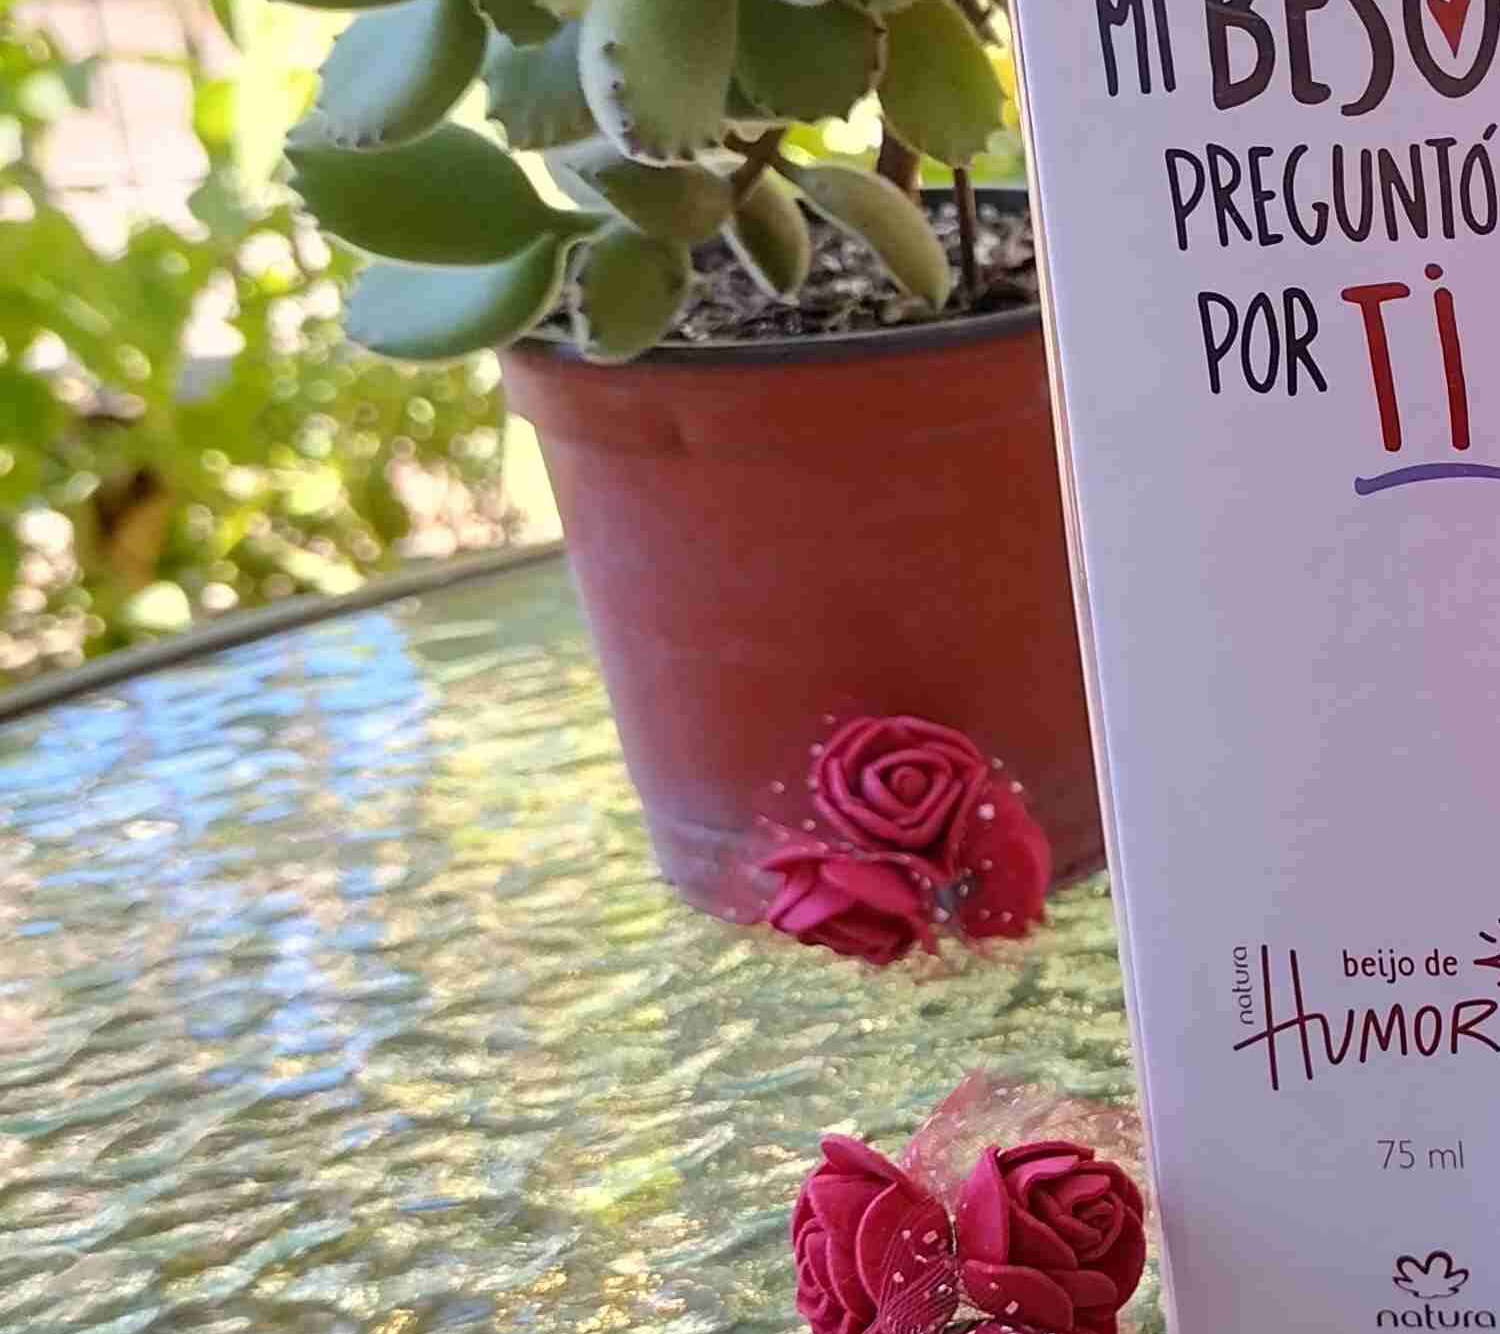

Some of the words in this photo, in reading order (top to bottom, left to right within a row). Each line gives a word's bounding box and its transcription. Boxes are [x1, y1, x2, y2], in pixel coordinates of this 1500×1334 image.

[1166, 123, 1498, 251] PREGUNTÓ
[1198, 287, 1328, 395] POR
[1232, 945, 1254, 1025] natura
[1343, 950, 1416, 984] beijo
[1425, 948, 1458, 976] de
[1377, 1140, 1415, 1169] 75
[1428, 1140, 1464, 1169] ml
[1376, 1303, 1497, 1330] natura
